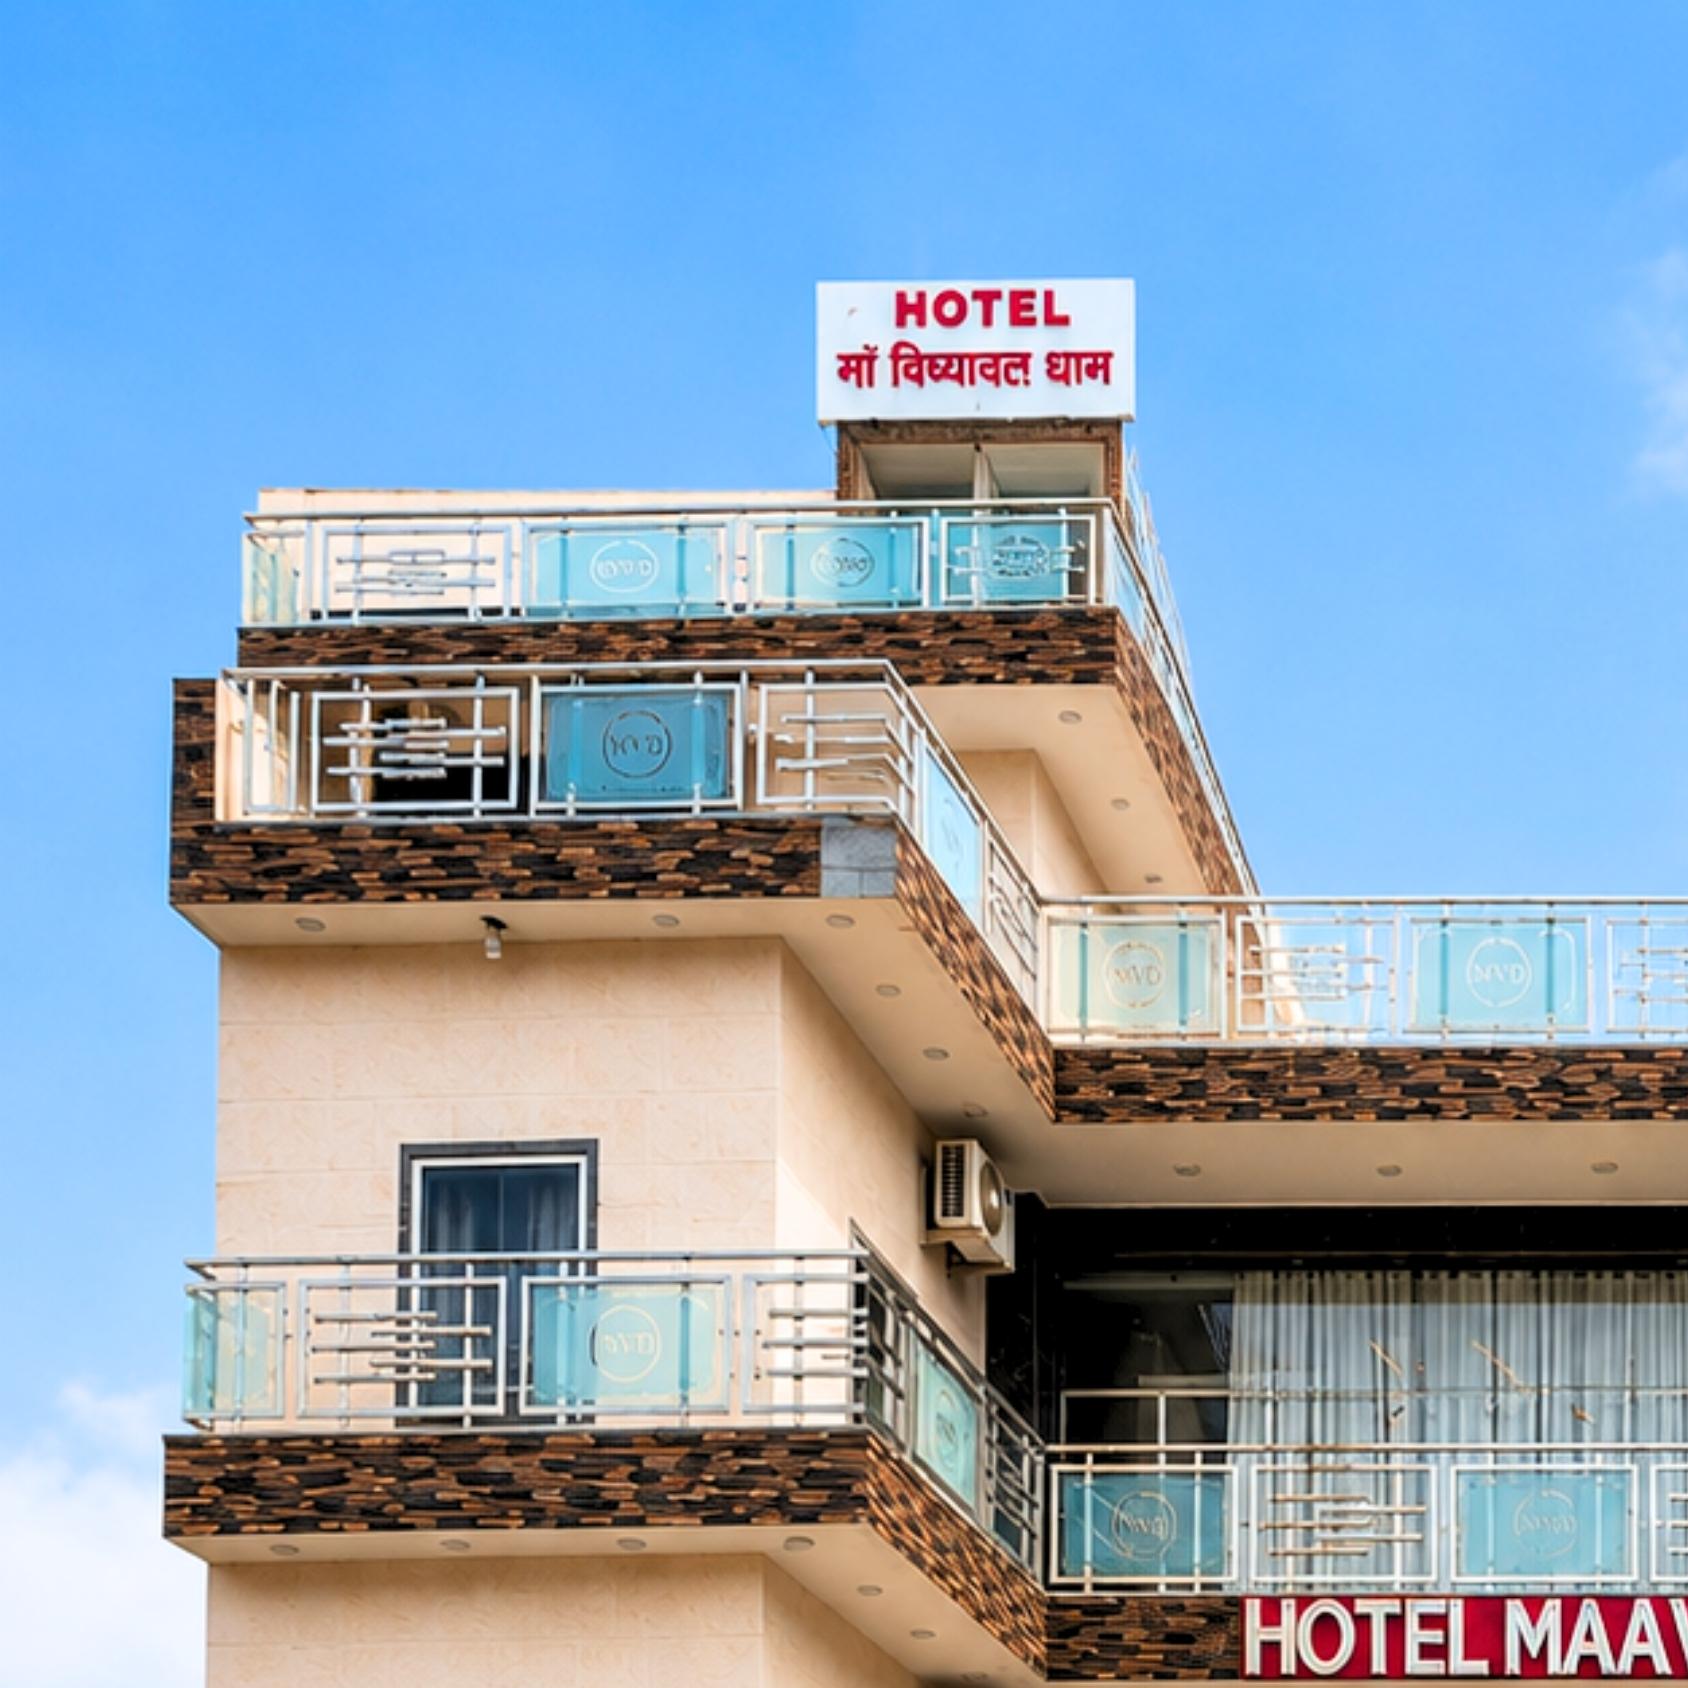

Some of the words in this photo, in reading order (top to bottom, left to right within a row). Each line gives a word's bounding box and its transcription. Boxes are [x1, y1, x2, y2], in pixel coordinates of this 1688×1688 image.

[895, 289, 1071, 328] HOTEL
[1045, 350, 1114, 387] धाम
[1245, 1597, 1490, 1676] HOTEL
